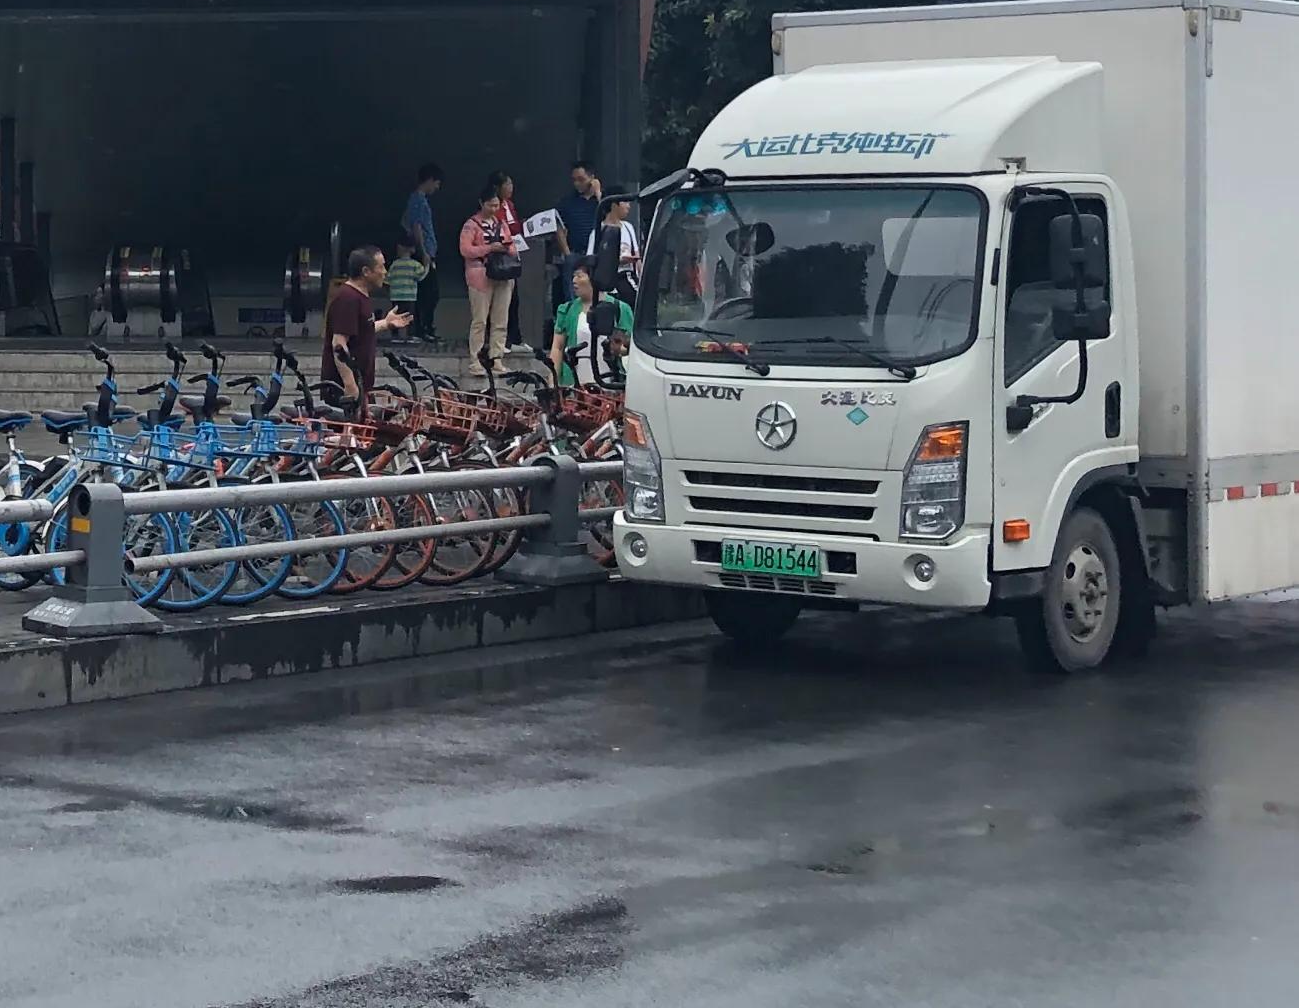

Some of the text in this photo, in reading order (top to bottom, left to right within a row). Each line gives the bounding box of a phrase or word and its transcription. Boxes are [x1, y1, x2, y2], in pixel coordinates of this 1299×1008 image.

[720, 131, 948, 160] 大运比克纯电动
[669, 383, 744, 401] DAYUN
